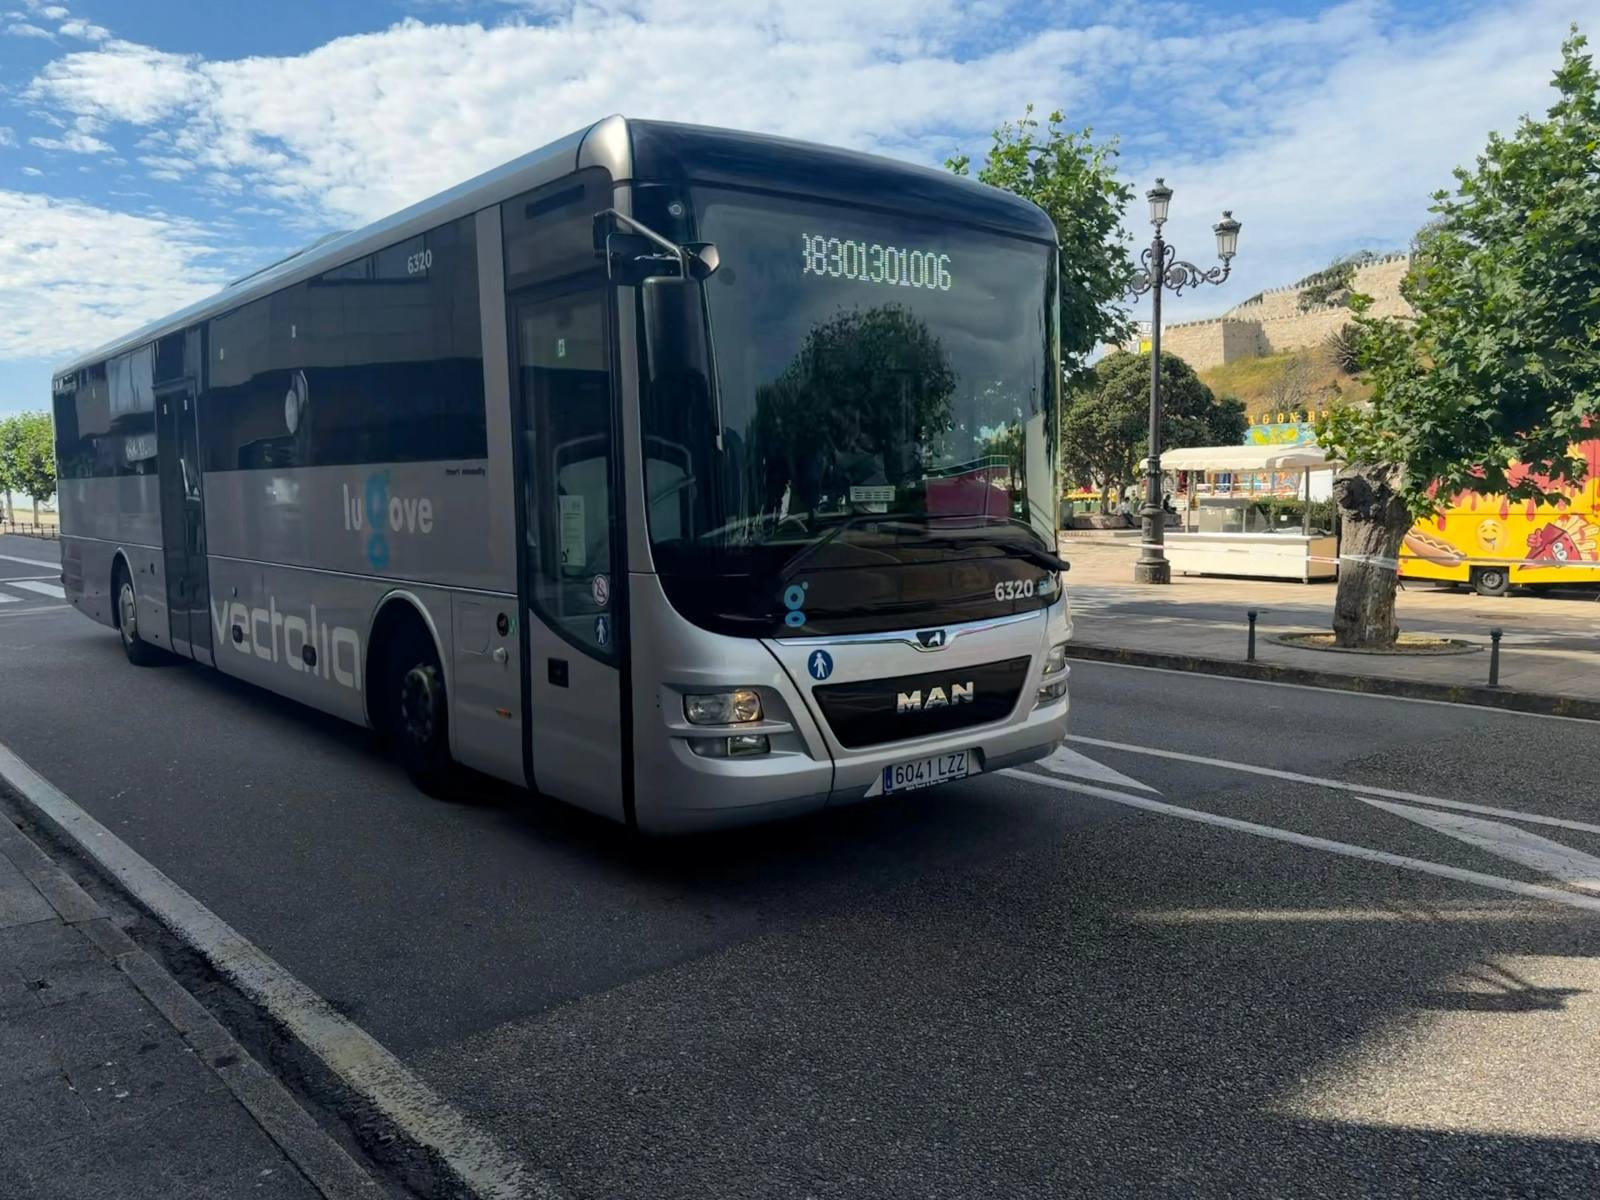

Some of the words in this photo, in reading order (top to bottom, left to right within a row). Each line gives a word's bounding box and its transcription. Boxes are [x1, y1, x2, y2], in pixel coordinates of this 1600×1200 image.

[407, 249, 432, 275] 6320
[994, 579, 1034, 602] 6320
[211, 596, 362, 690] vectalia
[897, 681, 974, 714] MAN
[895, 760, 932, 784] 6041
[938, 753, 965, 776] LZZ
